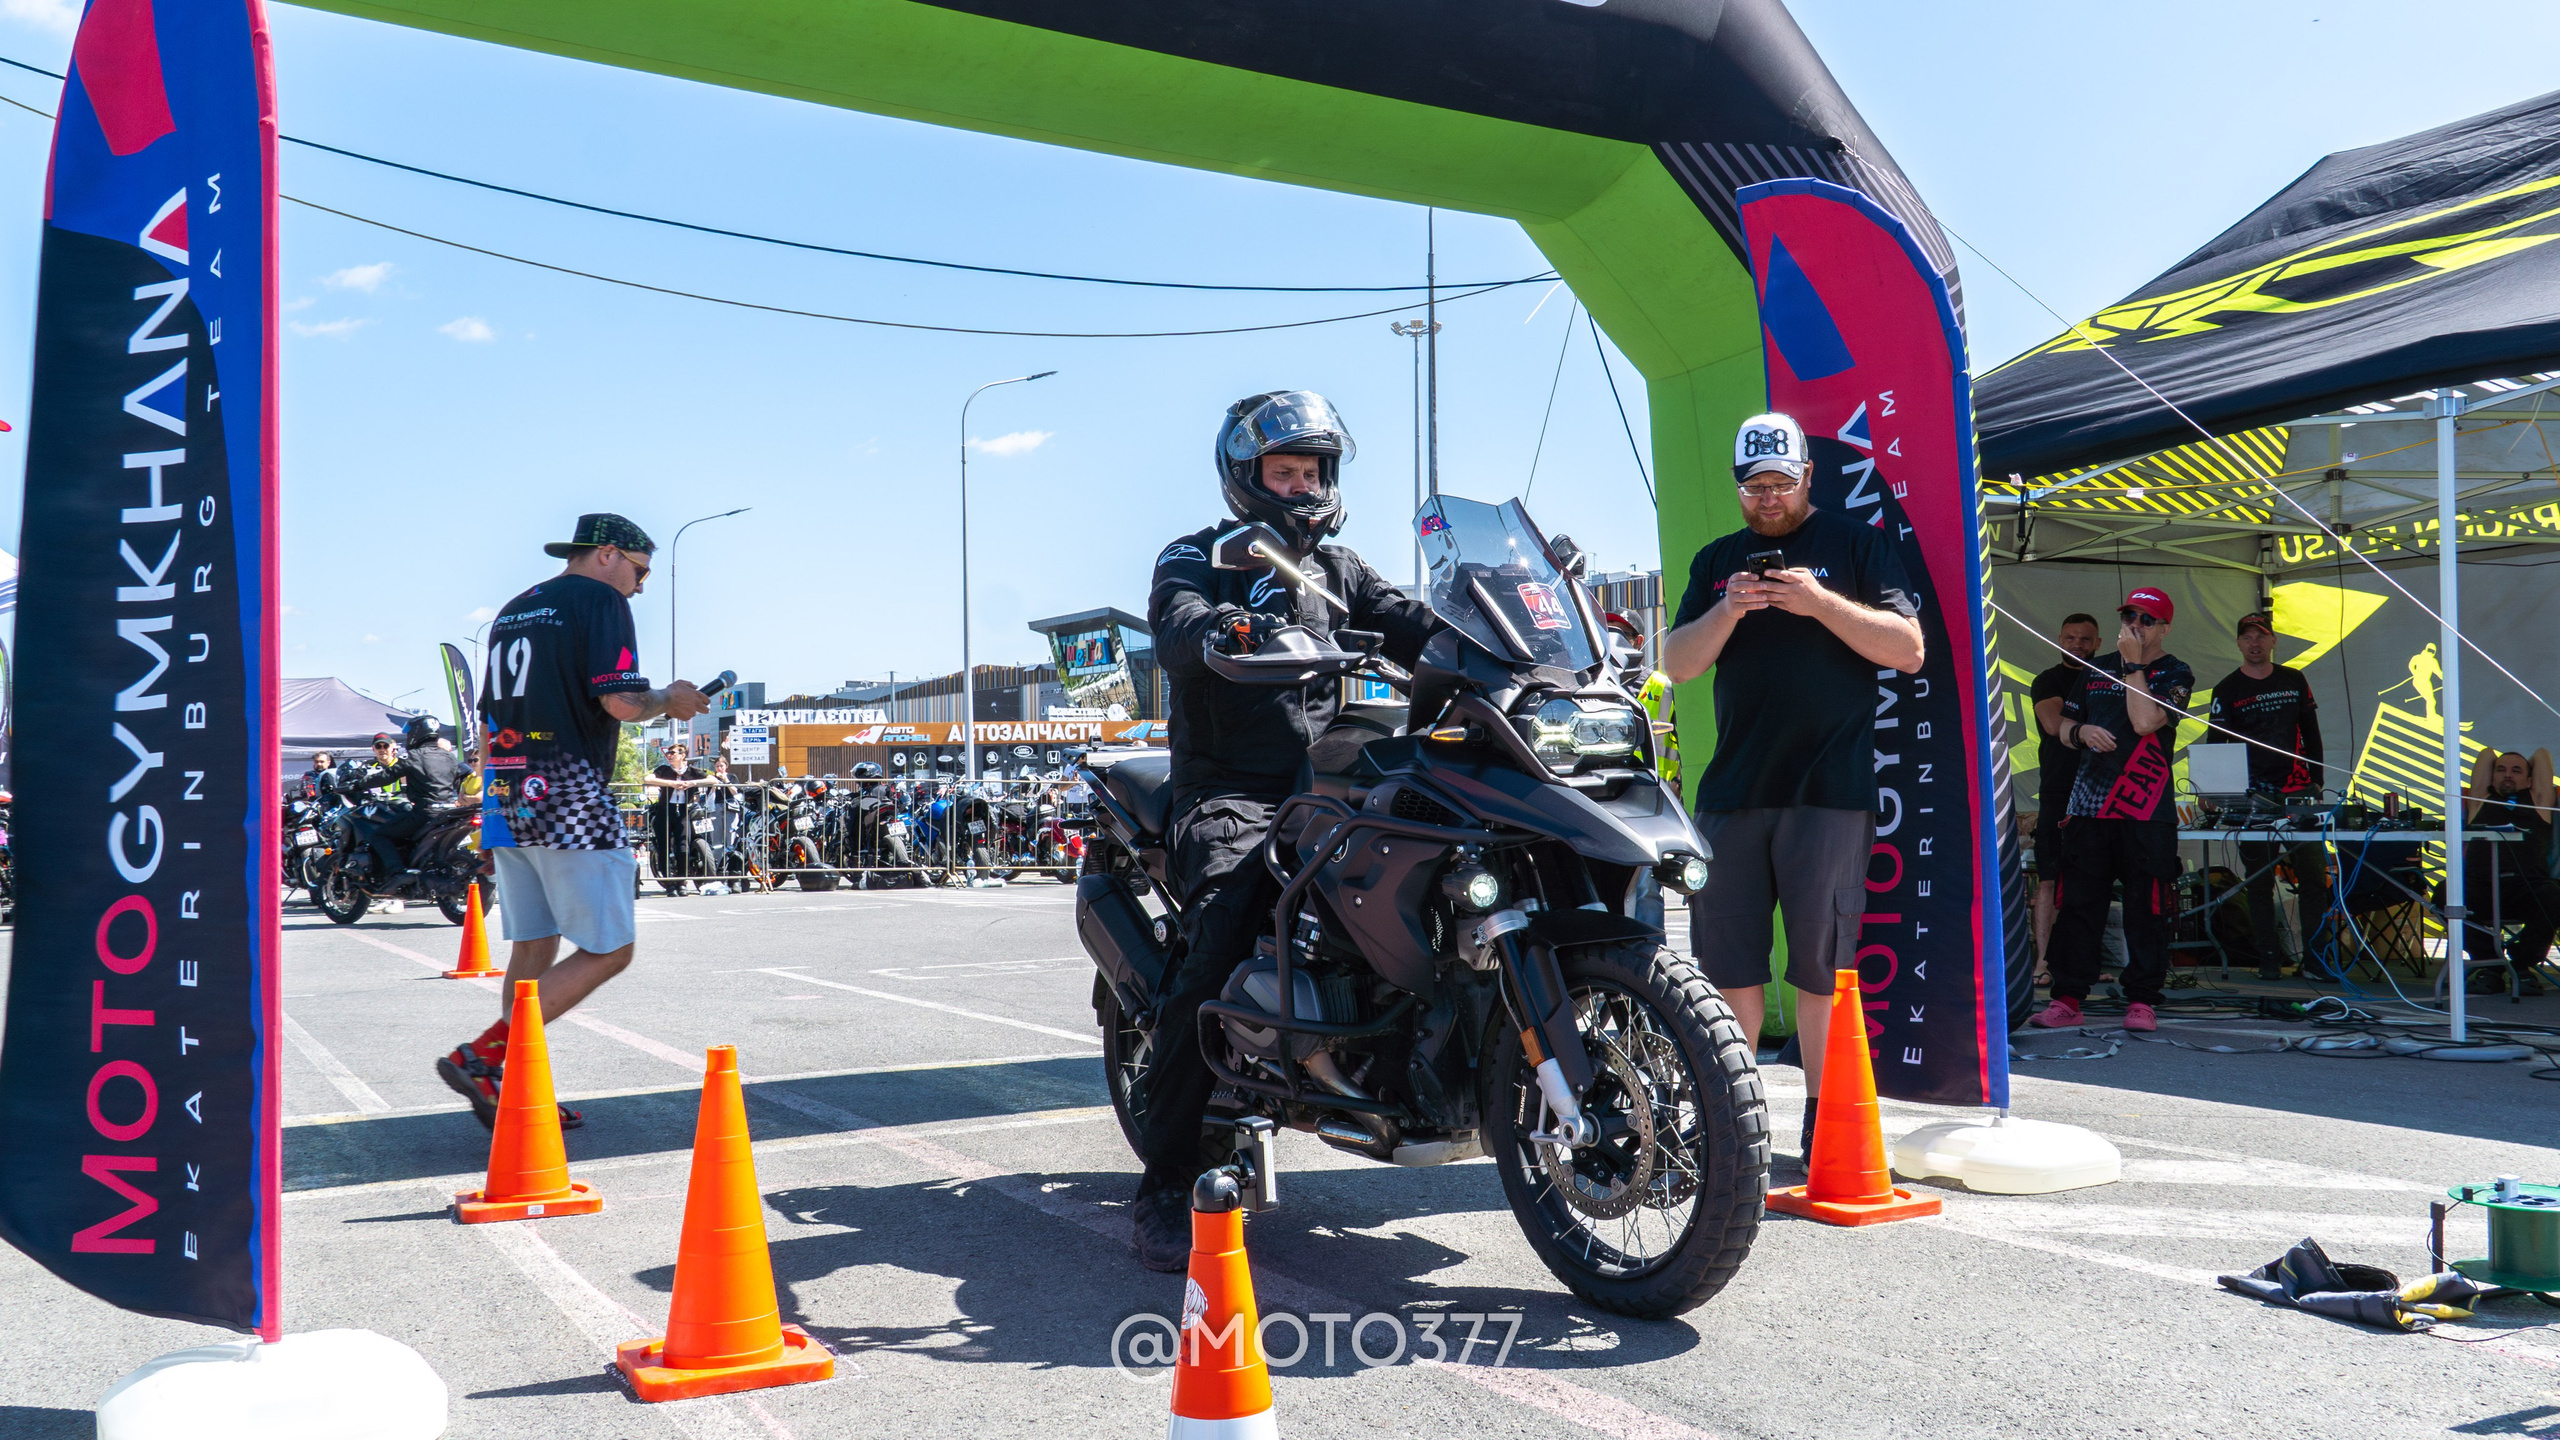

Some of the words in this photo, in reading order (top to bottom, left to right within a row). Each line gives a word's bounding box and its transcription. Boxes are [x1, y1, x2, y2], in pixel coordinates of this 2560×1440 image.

[1878, 389, 1913, 541] TEAM
[535, 618, 564, 627] TEAM
[1538, 595, 1566, 616] 44
[490, 636, 532, 701] 19
[1372, 681, 1386, 698] P
[70, 186, 190, 1255] MOTOGYMKHANA
[178, 495, 217, 1262] EKATERINBURG
[206, 172, 223, 412] TEAM
[882, 733, 931, 743] ЯПОНЕЦ
[884, 726, 915, 734] АВТО
[2105, 742, 2166, 820] TEAM
